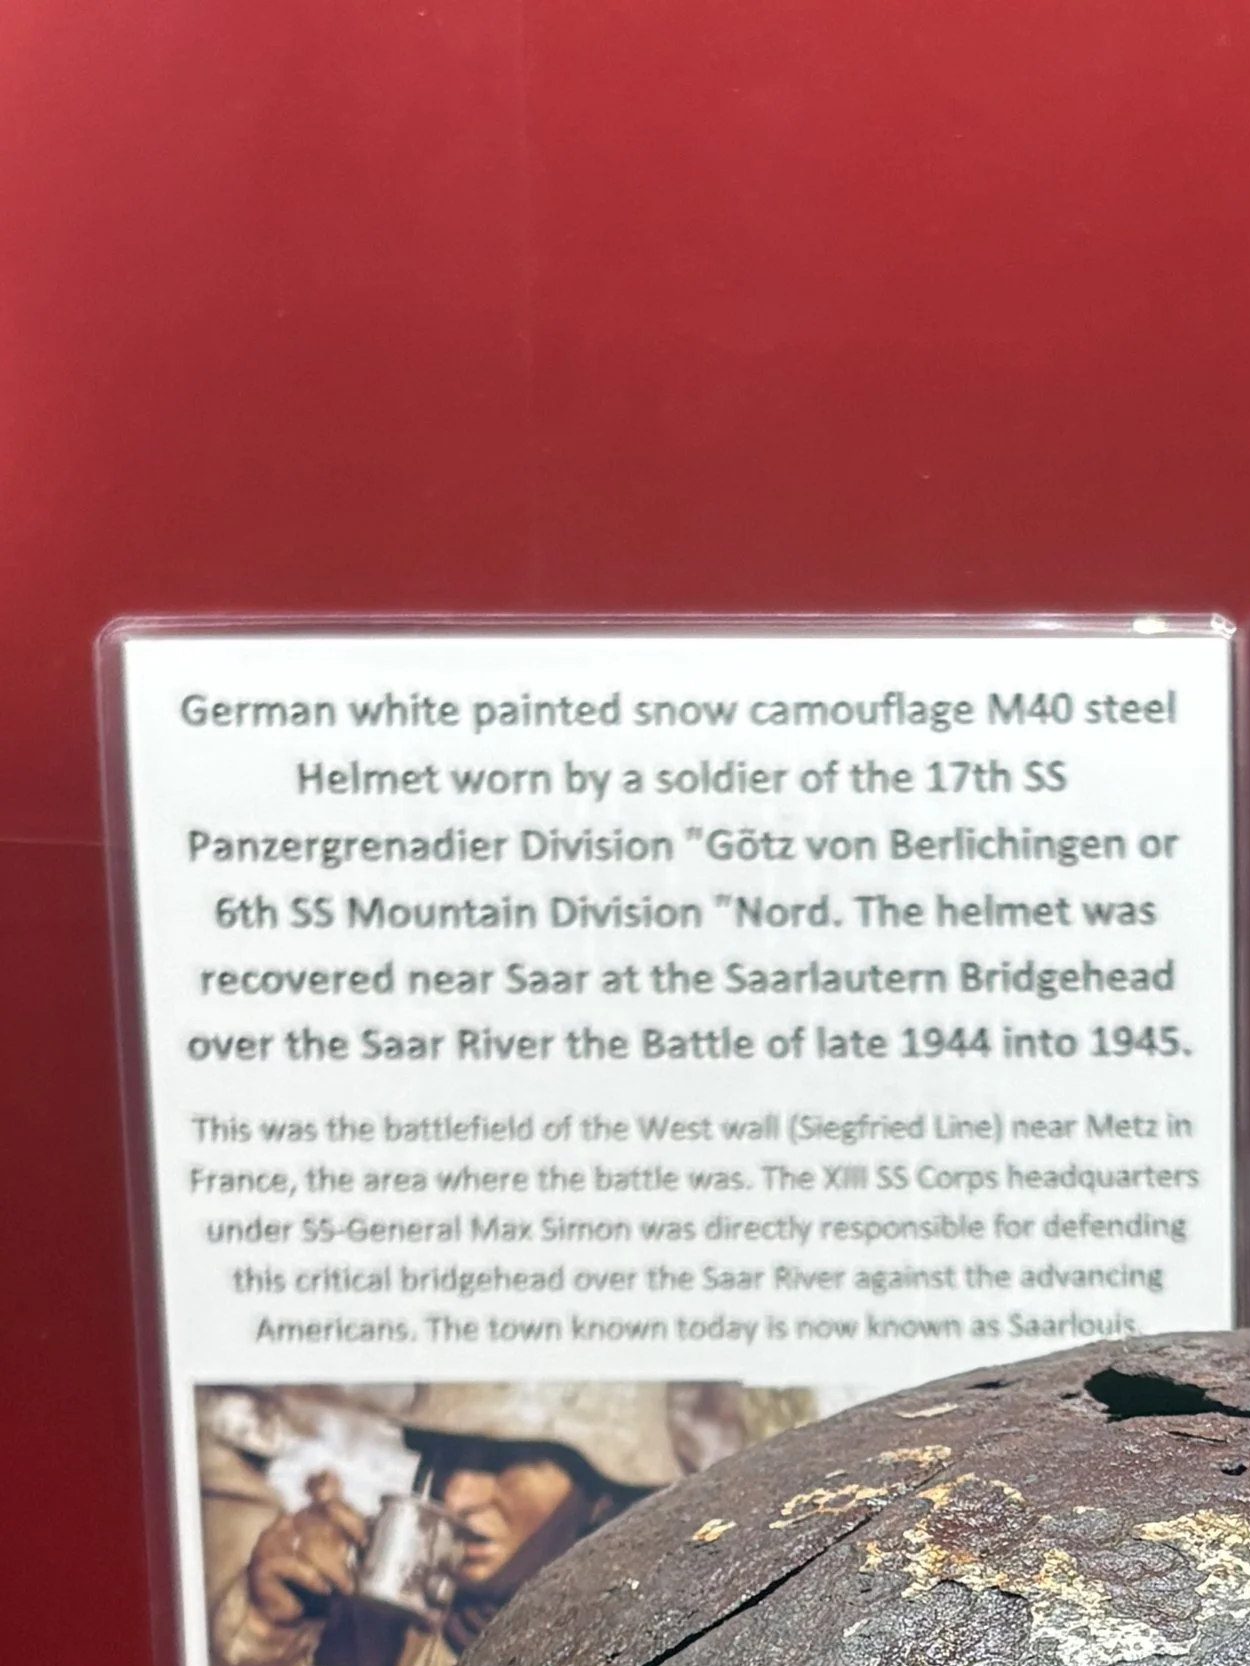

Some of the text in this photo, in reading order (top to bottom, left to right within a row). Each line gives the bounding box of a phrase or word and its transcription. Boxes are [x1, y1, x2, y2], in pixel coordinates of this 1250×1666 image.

[180, 691, 1176, 735] German white painted snow camouflage M40 steel
[296, 759, 1068, 802] Helmet worn by a soldier of the 17th SS
[187, 827, 509, 870] Panzergrenadier
[520, 828, 674, 861] Division
[804, 836, 877, 861] von
[890, 826, 1126, 867] Berlichingen
[1138, 834, 1180, 859] or
[214, 894, 278, 929] 6th
[289, 895, 335, 929] SS
[345, 894, 537, 928] Mountain
[549, 895, 703, 928] Division
[852, 894, 925, 927] The
[936, 893, 1072, 927] helmet
[1081, 901, 1157, 926] was
[200, 958, 1175, 1000] recovered near Saar at the Saarlautern Bridgehead
[186, 1025, 1192, 1061] over the Saar River the Battle of late 1944 into 1945.
[190, 1112, 1193, 1146] This was the battlefield of the West wall (Siegfried Line) near Metz in
[204, 1211, 1188, 1246] under SS-General Max Simon was directly responsible for defending
[254, 1316, 417, 1343] Americans.
[423, 1313, 479, 1342] The
[486, 1316, 563, 1342] town
[571, 1314, 668, 1340] known
[674, 1314, 759, 1346] today
[765, 1315, 789, 1340] is
[795, 1318, 859, 1340] now
[865, 1312, 964, 1339] known
[969, 1317, 1001, 1339] as
